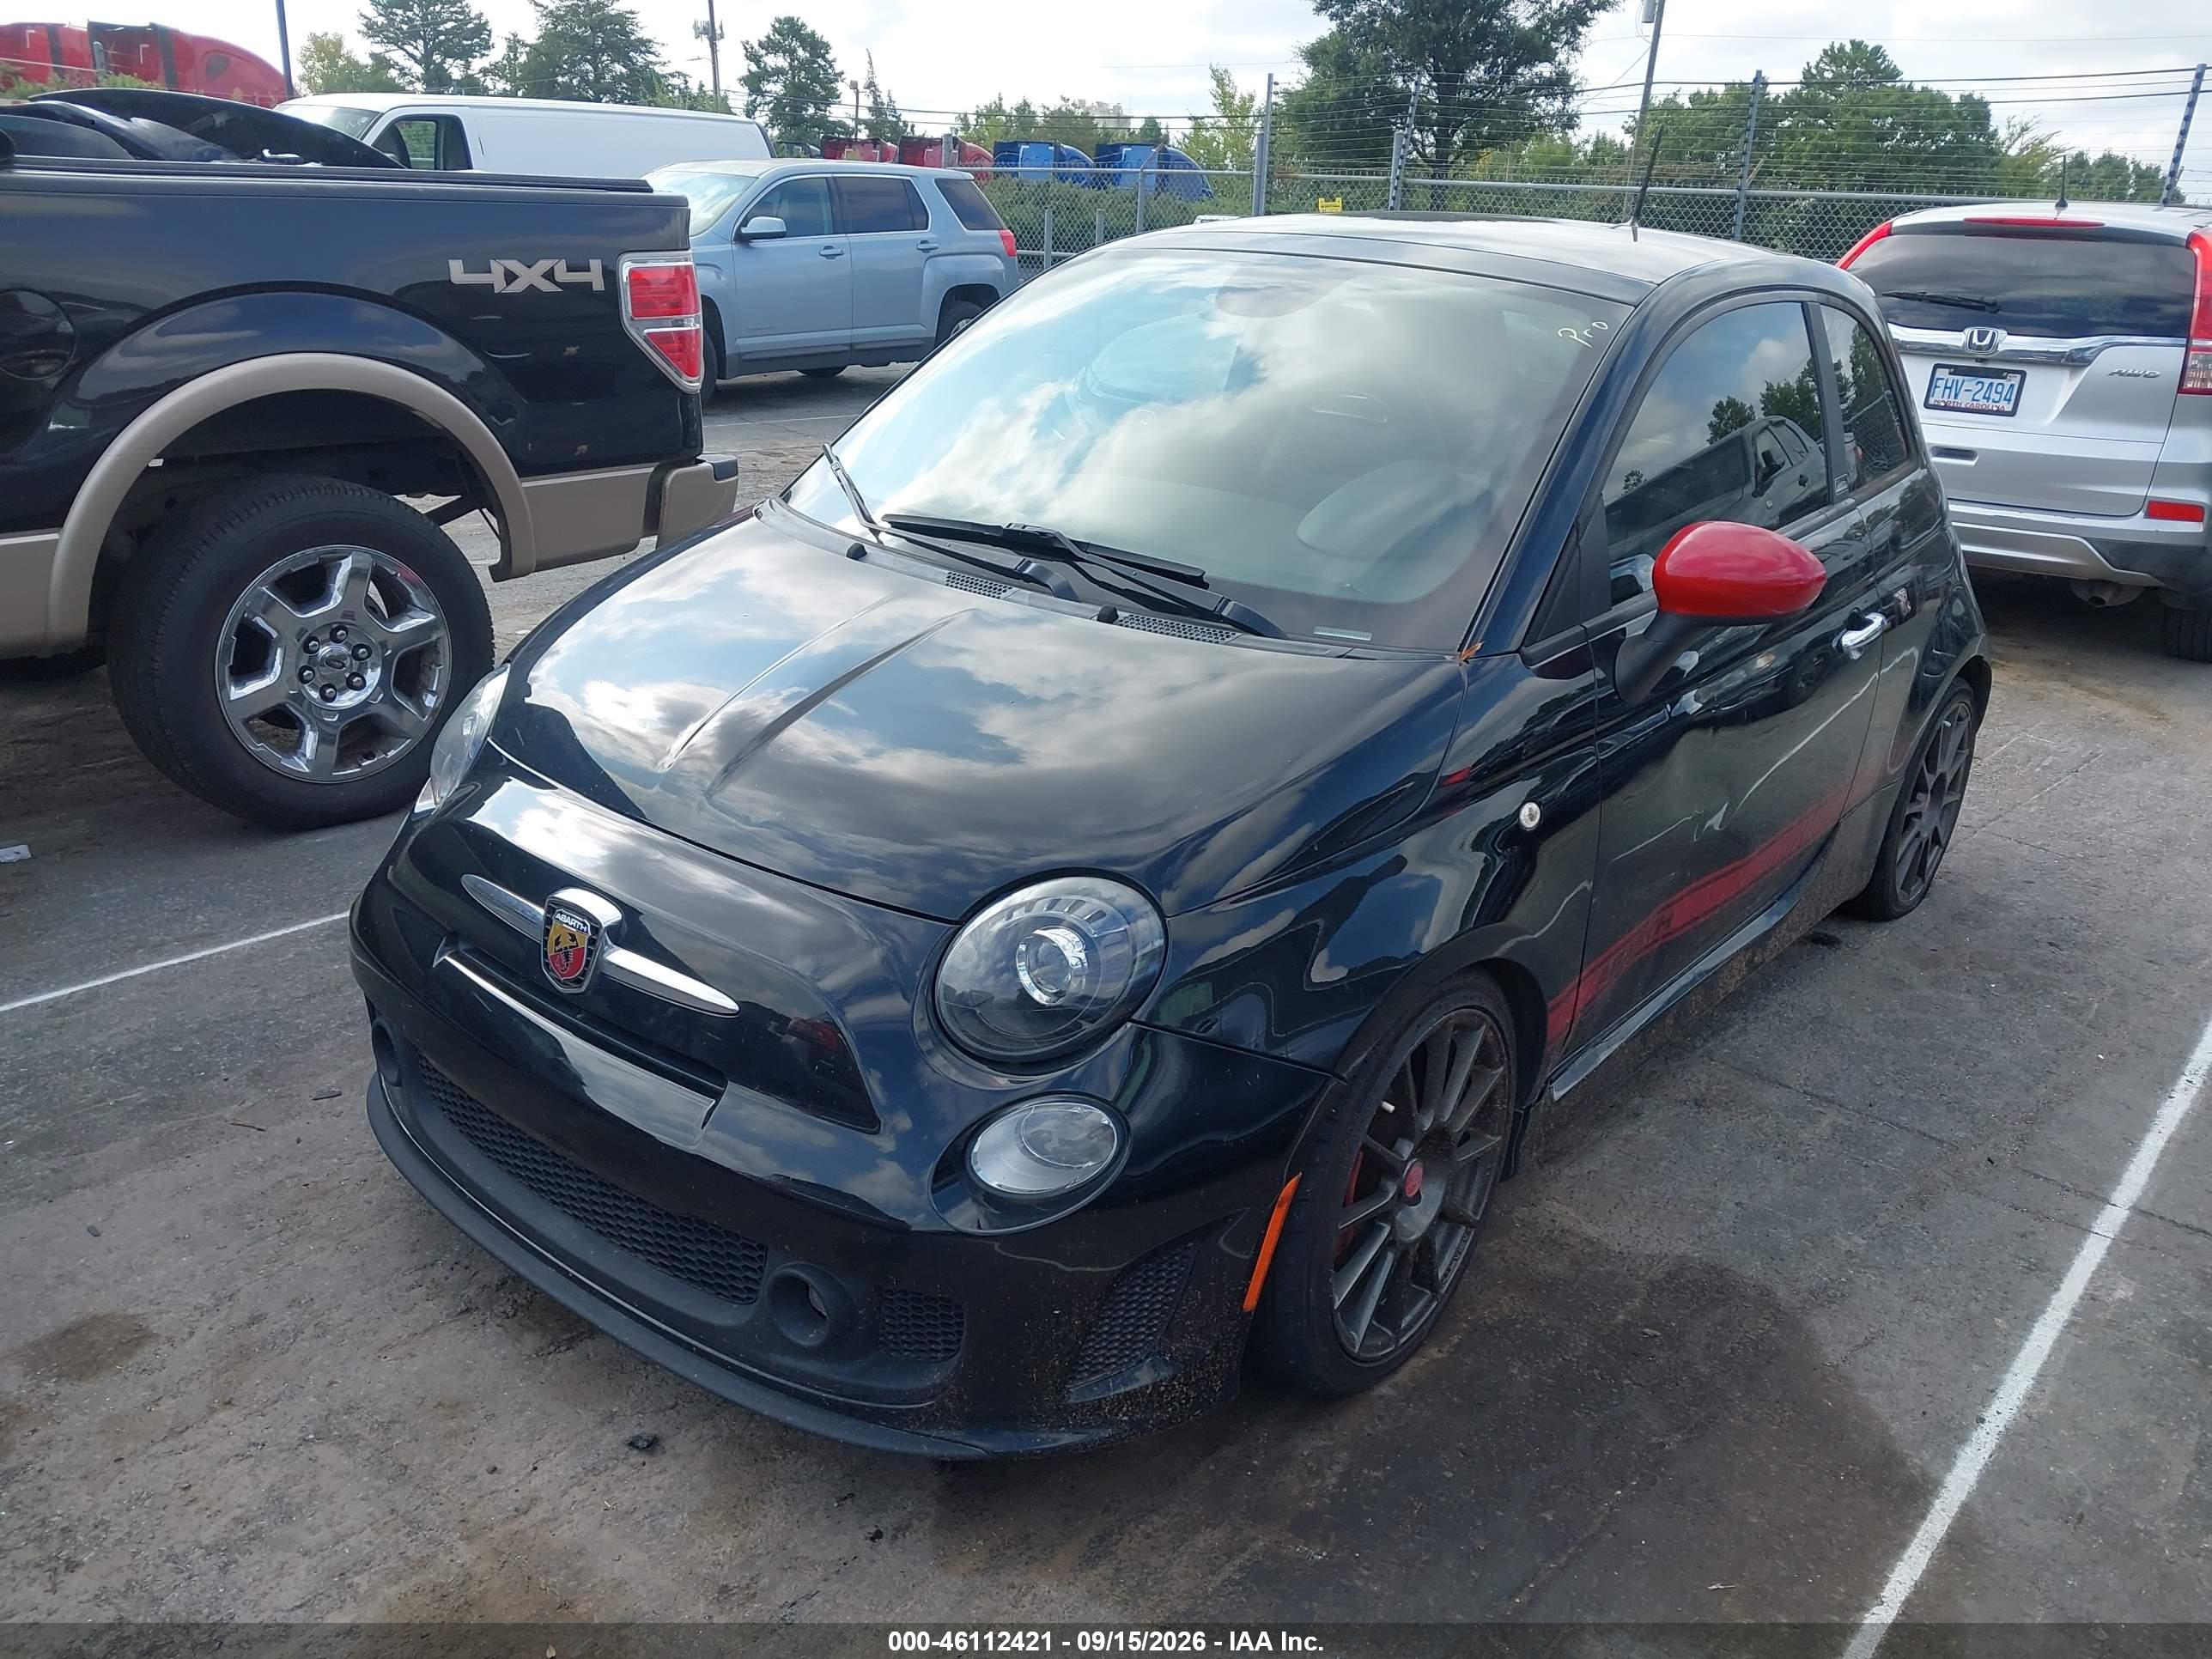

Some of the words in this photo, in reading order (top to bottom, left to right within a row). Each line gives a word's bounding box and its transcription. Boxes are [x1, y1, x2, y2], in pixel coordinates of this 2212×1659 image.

[447, 258, 605, 294] 4X4
[2107, 368, 2160, 379] AWD
[1930, 377, 2015, 404] FHV-2494
[555, 913, 587, 933] ABARTH
